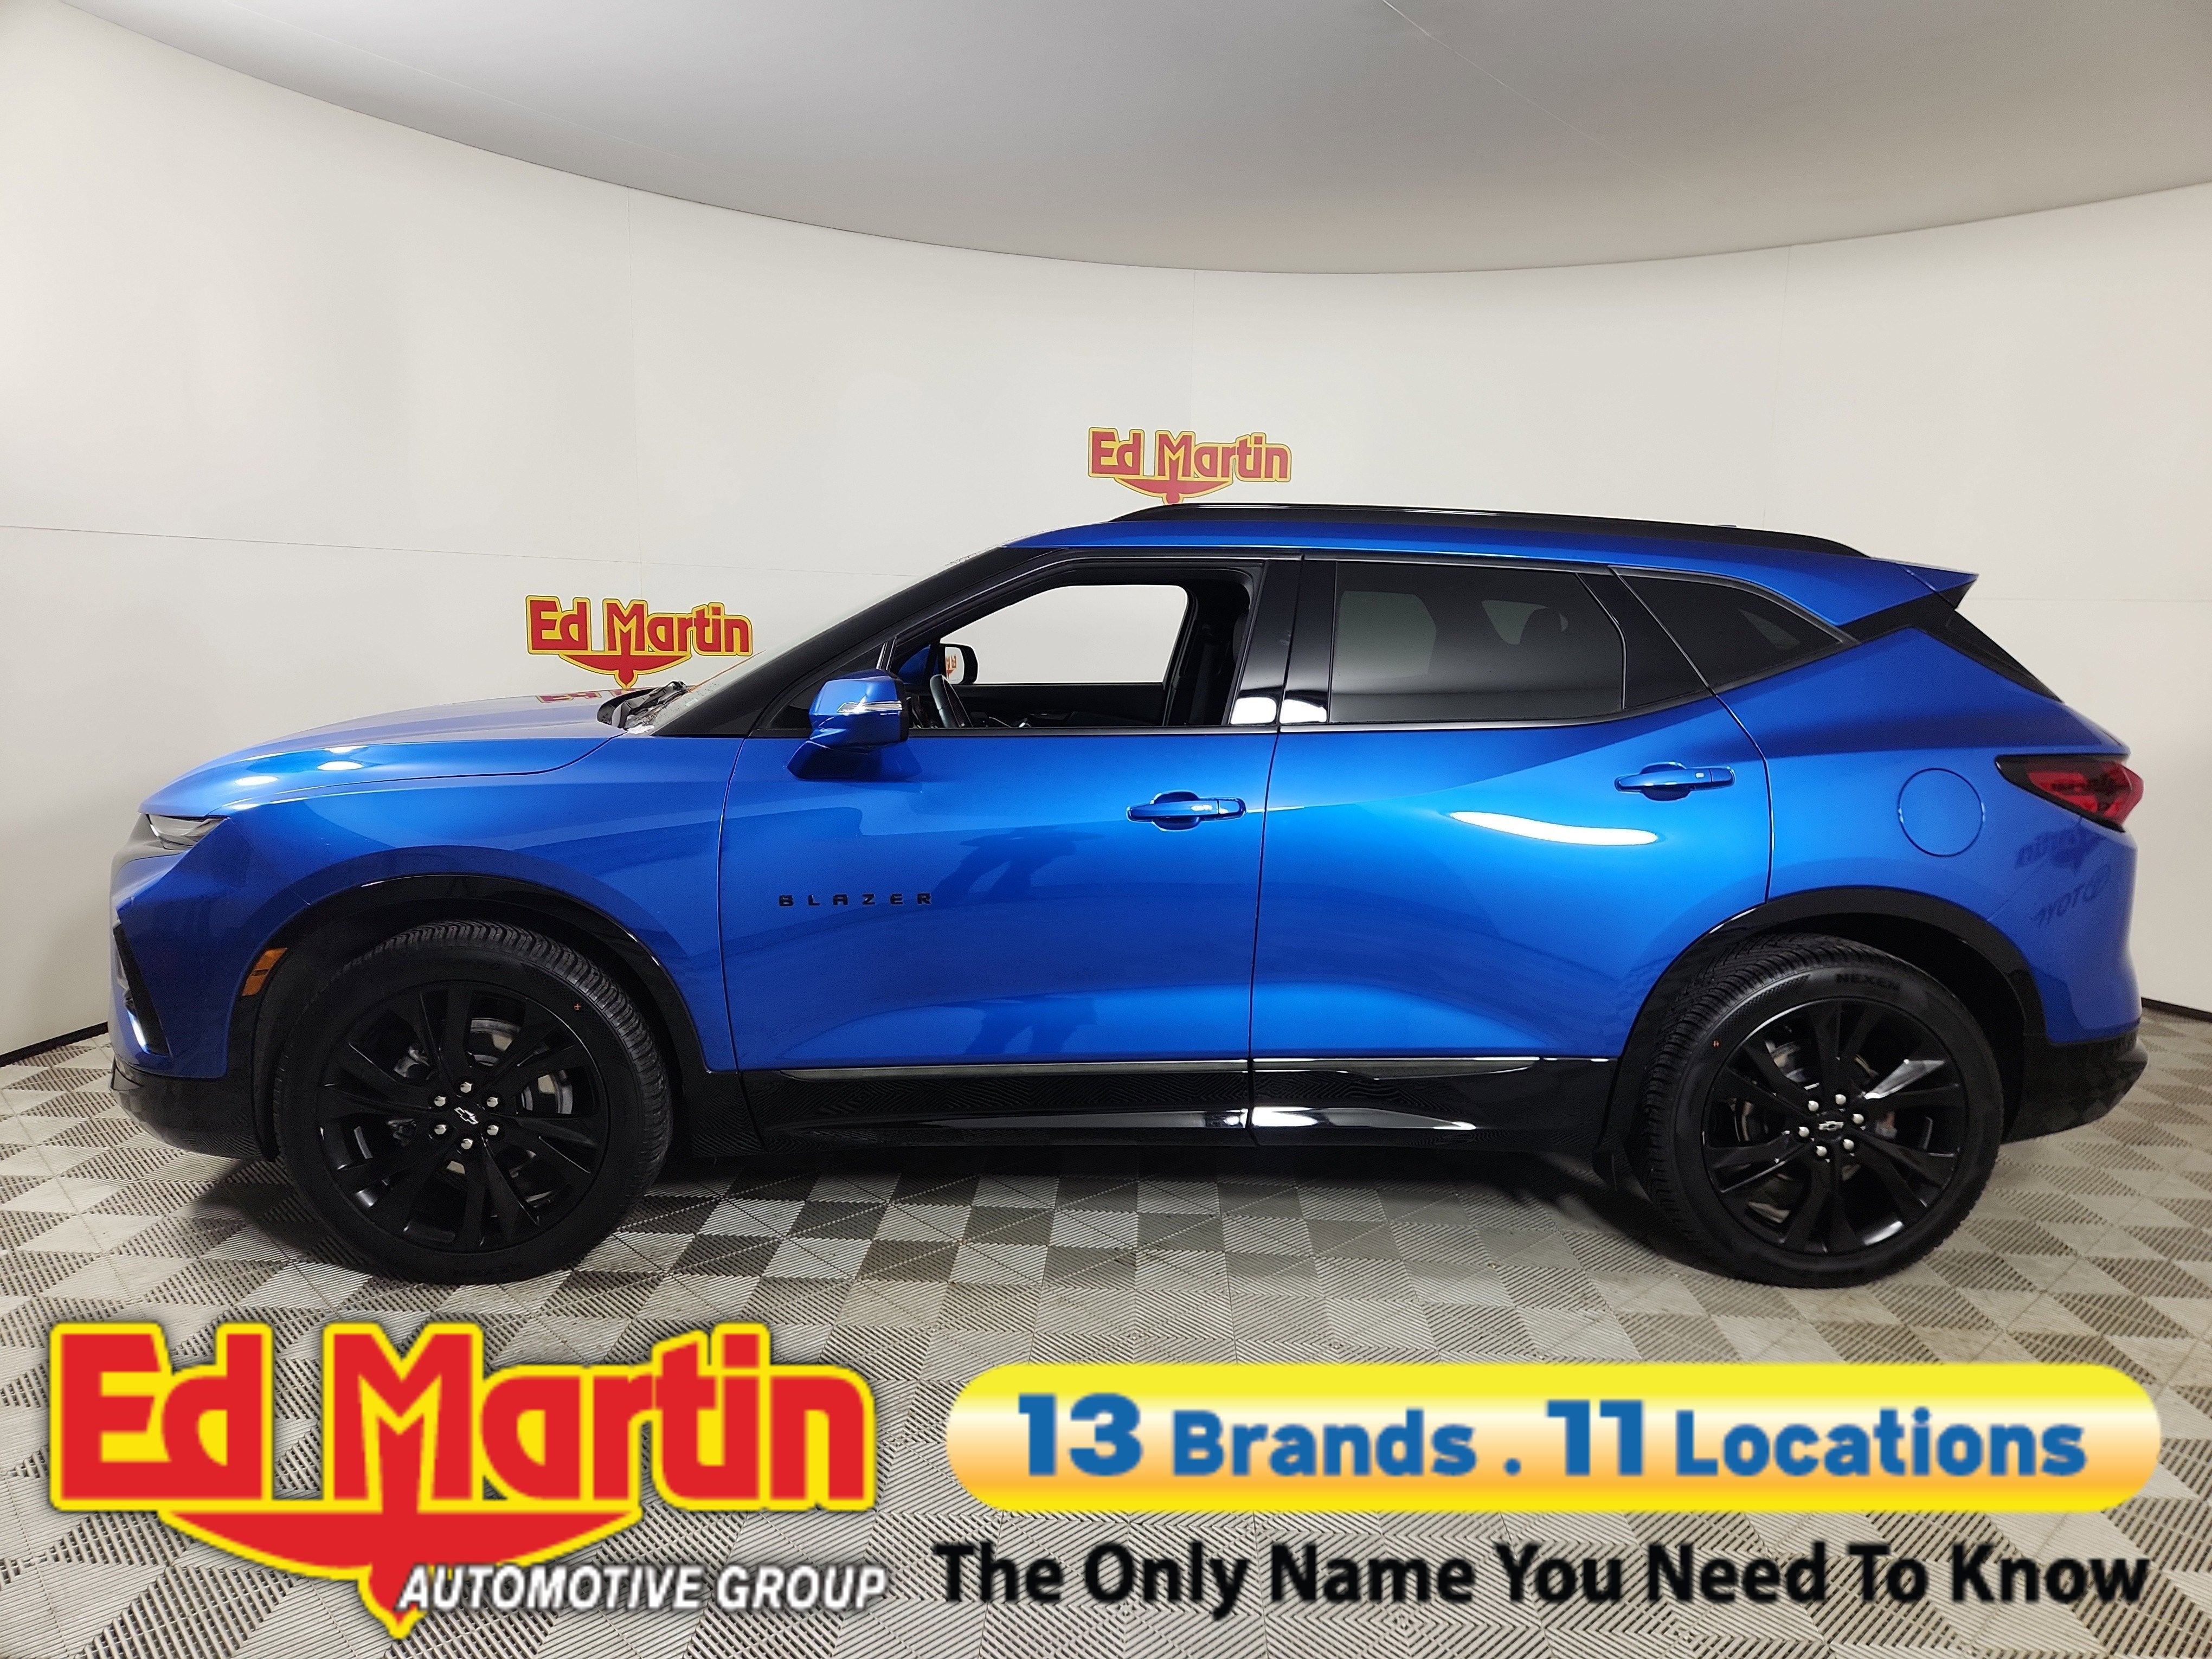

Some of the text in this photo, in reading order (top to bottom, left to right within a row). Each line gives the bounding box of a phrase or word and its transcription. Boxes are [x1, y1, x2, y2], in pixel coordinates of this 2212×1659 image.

[1089, 428, 1291, 481] Ed Martin
[527, 597, 751, 655] Ed Martin
[779, 893, 931, 906] BLAZER
